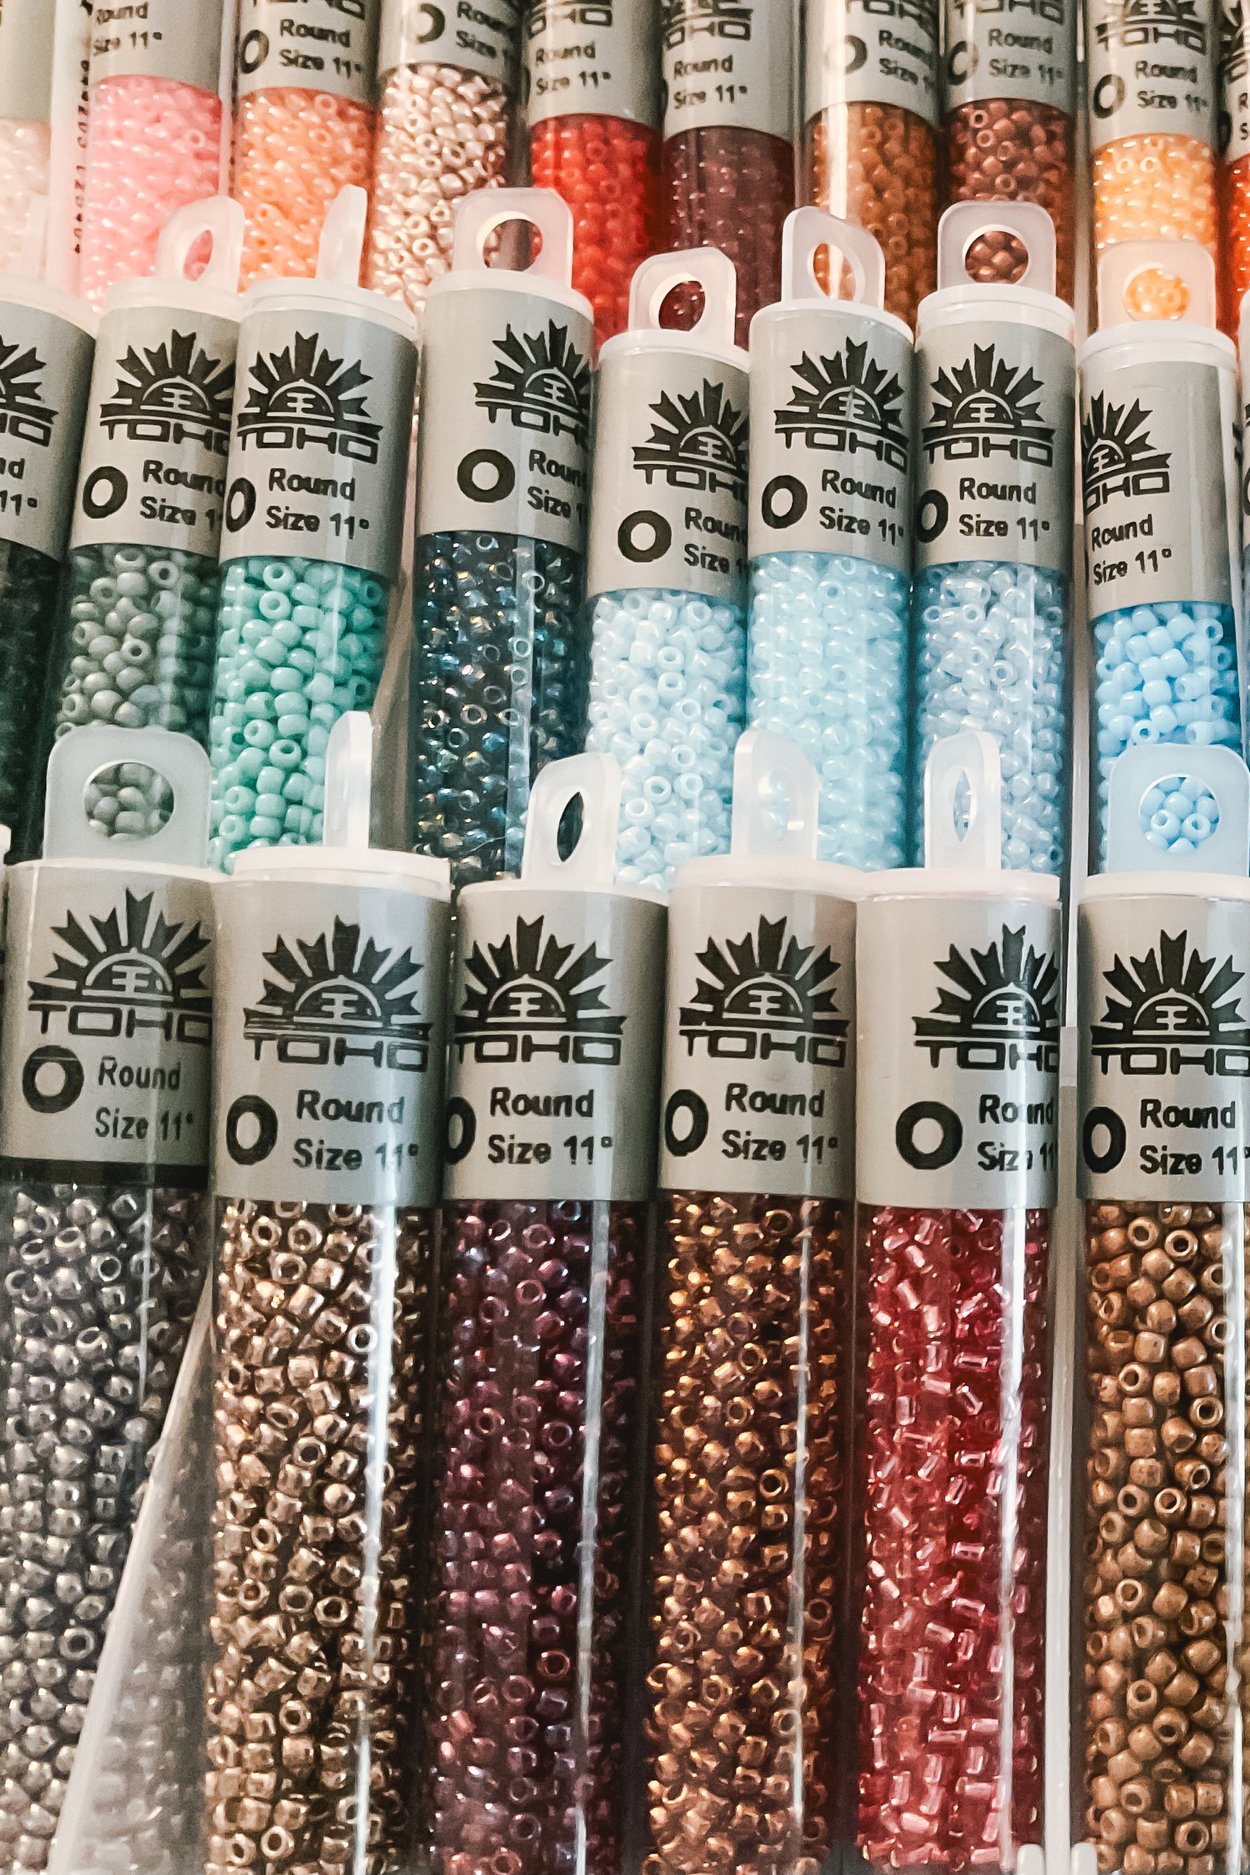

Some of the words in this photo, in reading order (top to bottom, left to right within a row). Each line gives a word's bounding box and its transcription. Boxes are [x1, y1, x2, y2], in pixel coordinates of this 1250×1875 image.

[475, 401, 588, 446] TOH
[239, 428, 380, 464] TOHO
[775, 426, 908, 475] TOHO
[923, 437, 1054, 467] TOHO
[268, 467, 355, 501] Round
[529, 450, 587, 486] Roun
[633, 464, 748, 505] TOH
[821, 470, 897, 508] Round
[959, 478, 1037, 503] Round
[1084, 469, 1170, 515] OHO
[141, 497, 198, 522] Size
[267, 506, 320, 530] Size
[528, 487, 572, 517] Size
[684, 507, 747, 542] Roun
[819, 507, 870, 535] Size
[959, 514, 1007, 537] Size
[1091, 514, 1153, 551] Round
[683, 543, 730, 574] Size
[1092, 554, 1127, 584] Size
[28, 1004, 211, 1044] TOHO
[245, 1036, 428, 1073] TOHO
[454, 1035, 620, 1066] TOHO
[680, 1031, 845, 1068] TOHO
[99, 1057, 182, 1092] Round
[296, 1089, 406, 1125] Round
[490, 1087, 594, 1118] Round
[726, 1084, 824, 1118] Round
[1140, 1100, 1236, 1129] Round
[96, 1108, 148, 1139] Size
[293, 1138, 363, 1172] Size
[488, 1136, 551, 1165] Size
[722, 1130, 785, 1161] Size
[1038, 1144, 1055, 1170] 11
[1140, 1146, 1201, 1174] Size
